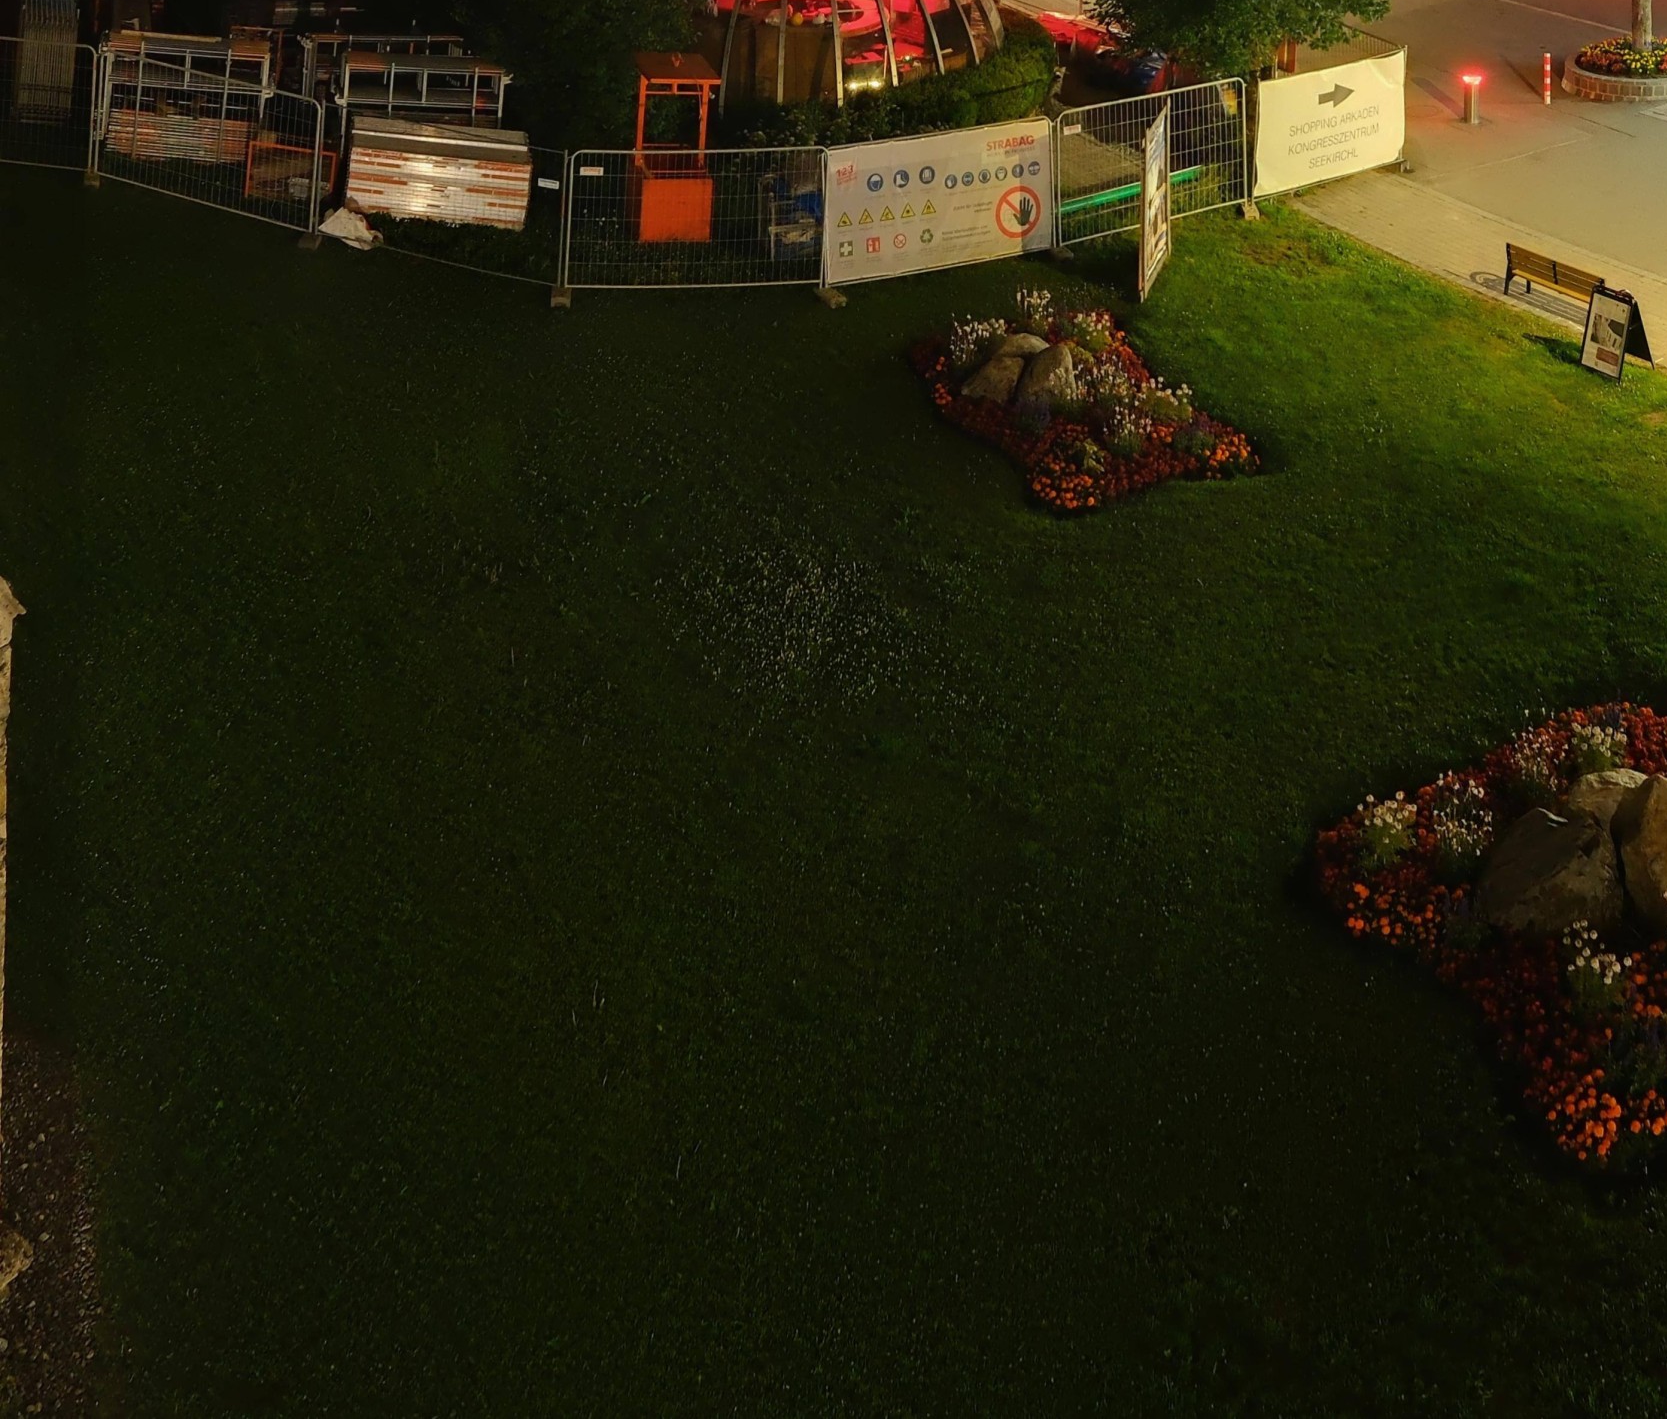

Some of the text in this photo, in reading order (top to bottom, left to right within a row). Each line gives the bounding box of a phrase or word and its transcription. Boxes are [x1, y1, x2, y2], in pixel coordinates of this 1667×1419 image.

[1289, 105, 1380, 138] SHOPPING ARKADEN
[986, 135, 1035, 152] STRABAG
[1288, 124, 1380, 156] KONGRESSZENTRUM
[1308, 148, 1358, 169] SEEKIRCHL
